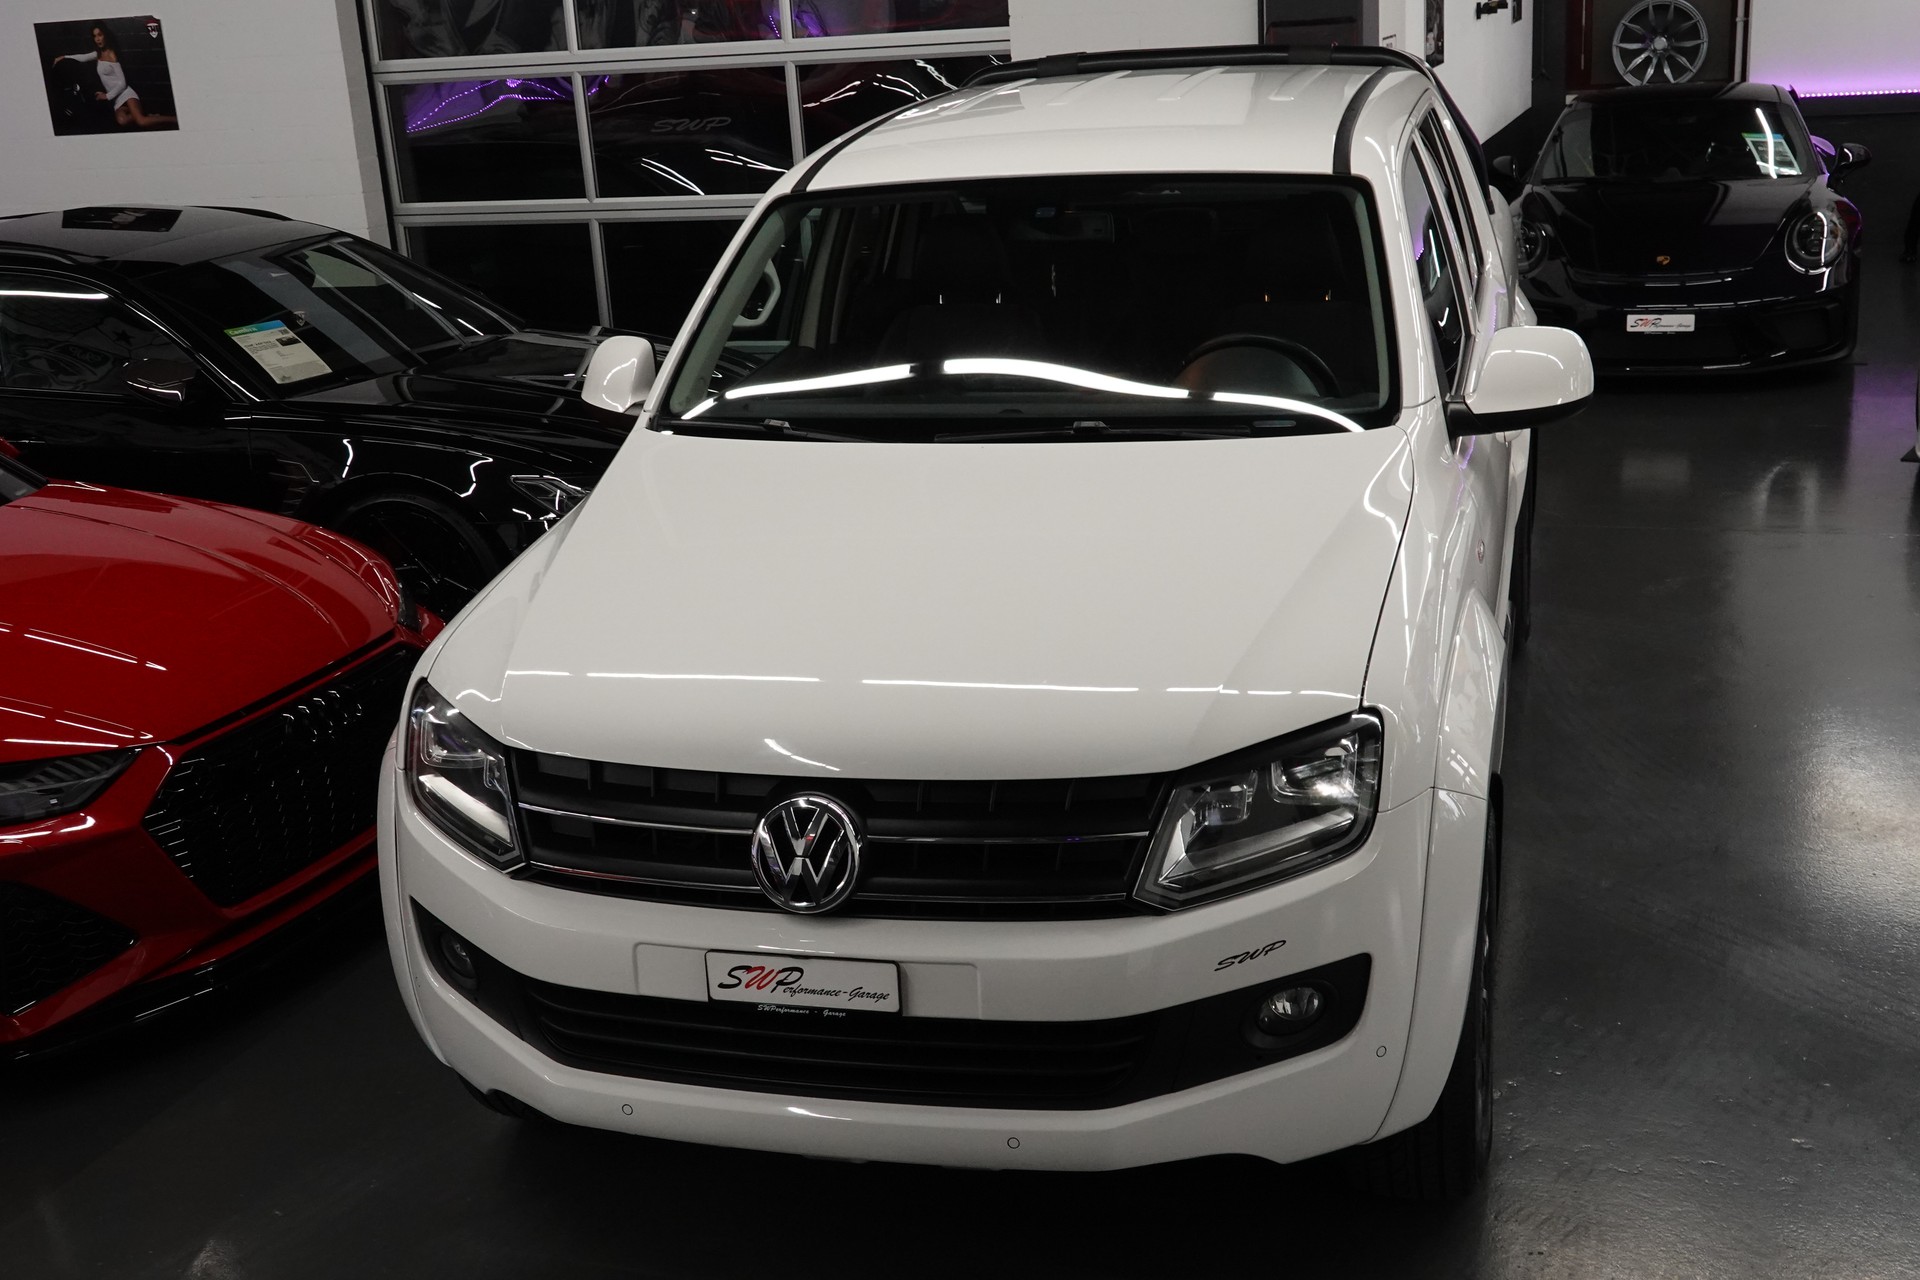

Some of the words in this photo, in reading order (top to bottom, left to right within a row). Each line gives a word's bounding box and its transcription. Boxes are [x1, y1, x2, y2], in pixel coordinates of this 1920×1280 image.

[650, 116, 732, 133] SWP
[1214, 939, 1287, 972] SWP
[757, 1004, 810, 1014] SWPerformance
[822, 1009, 847, 1018] Garage
